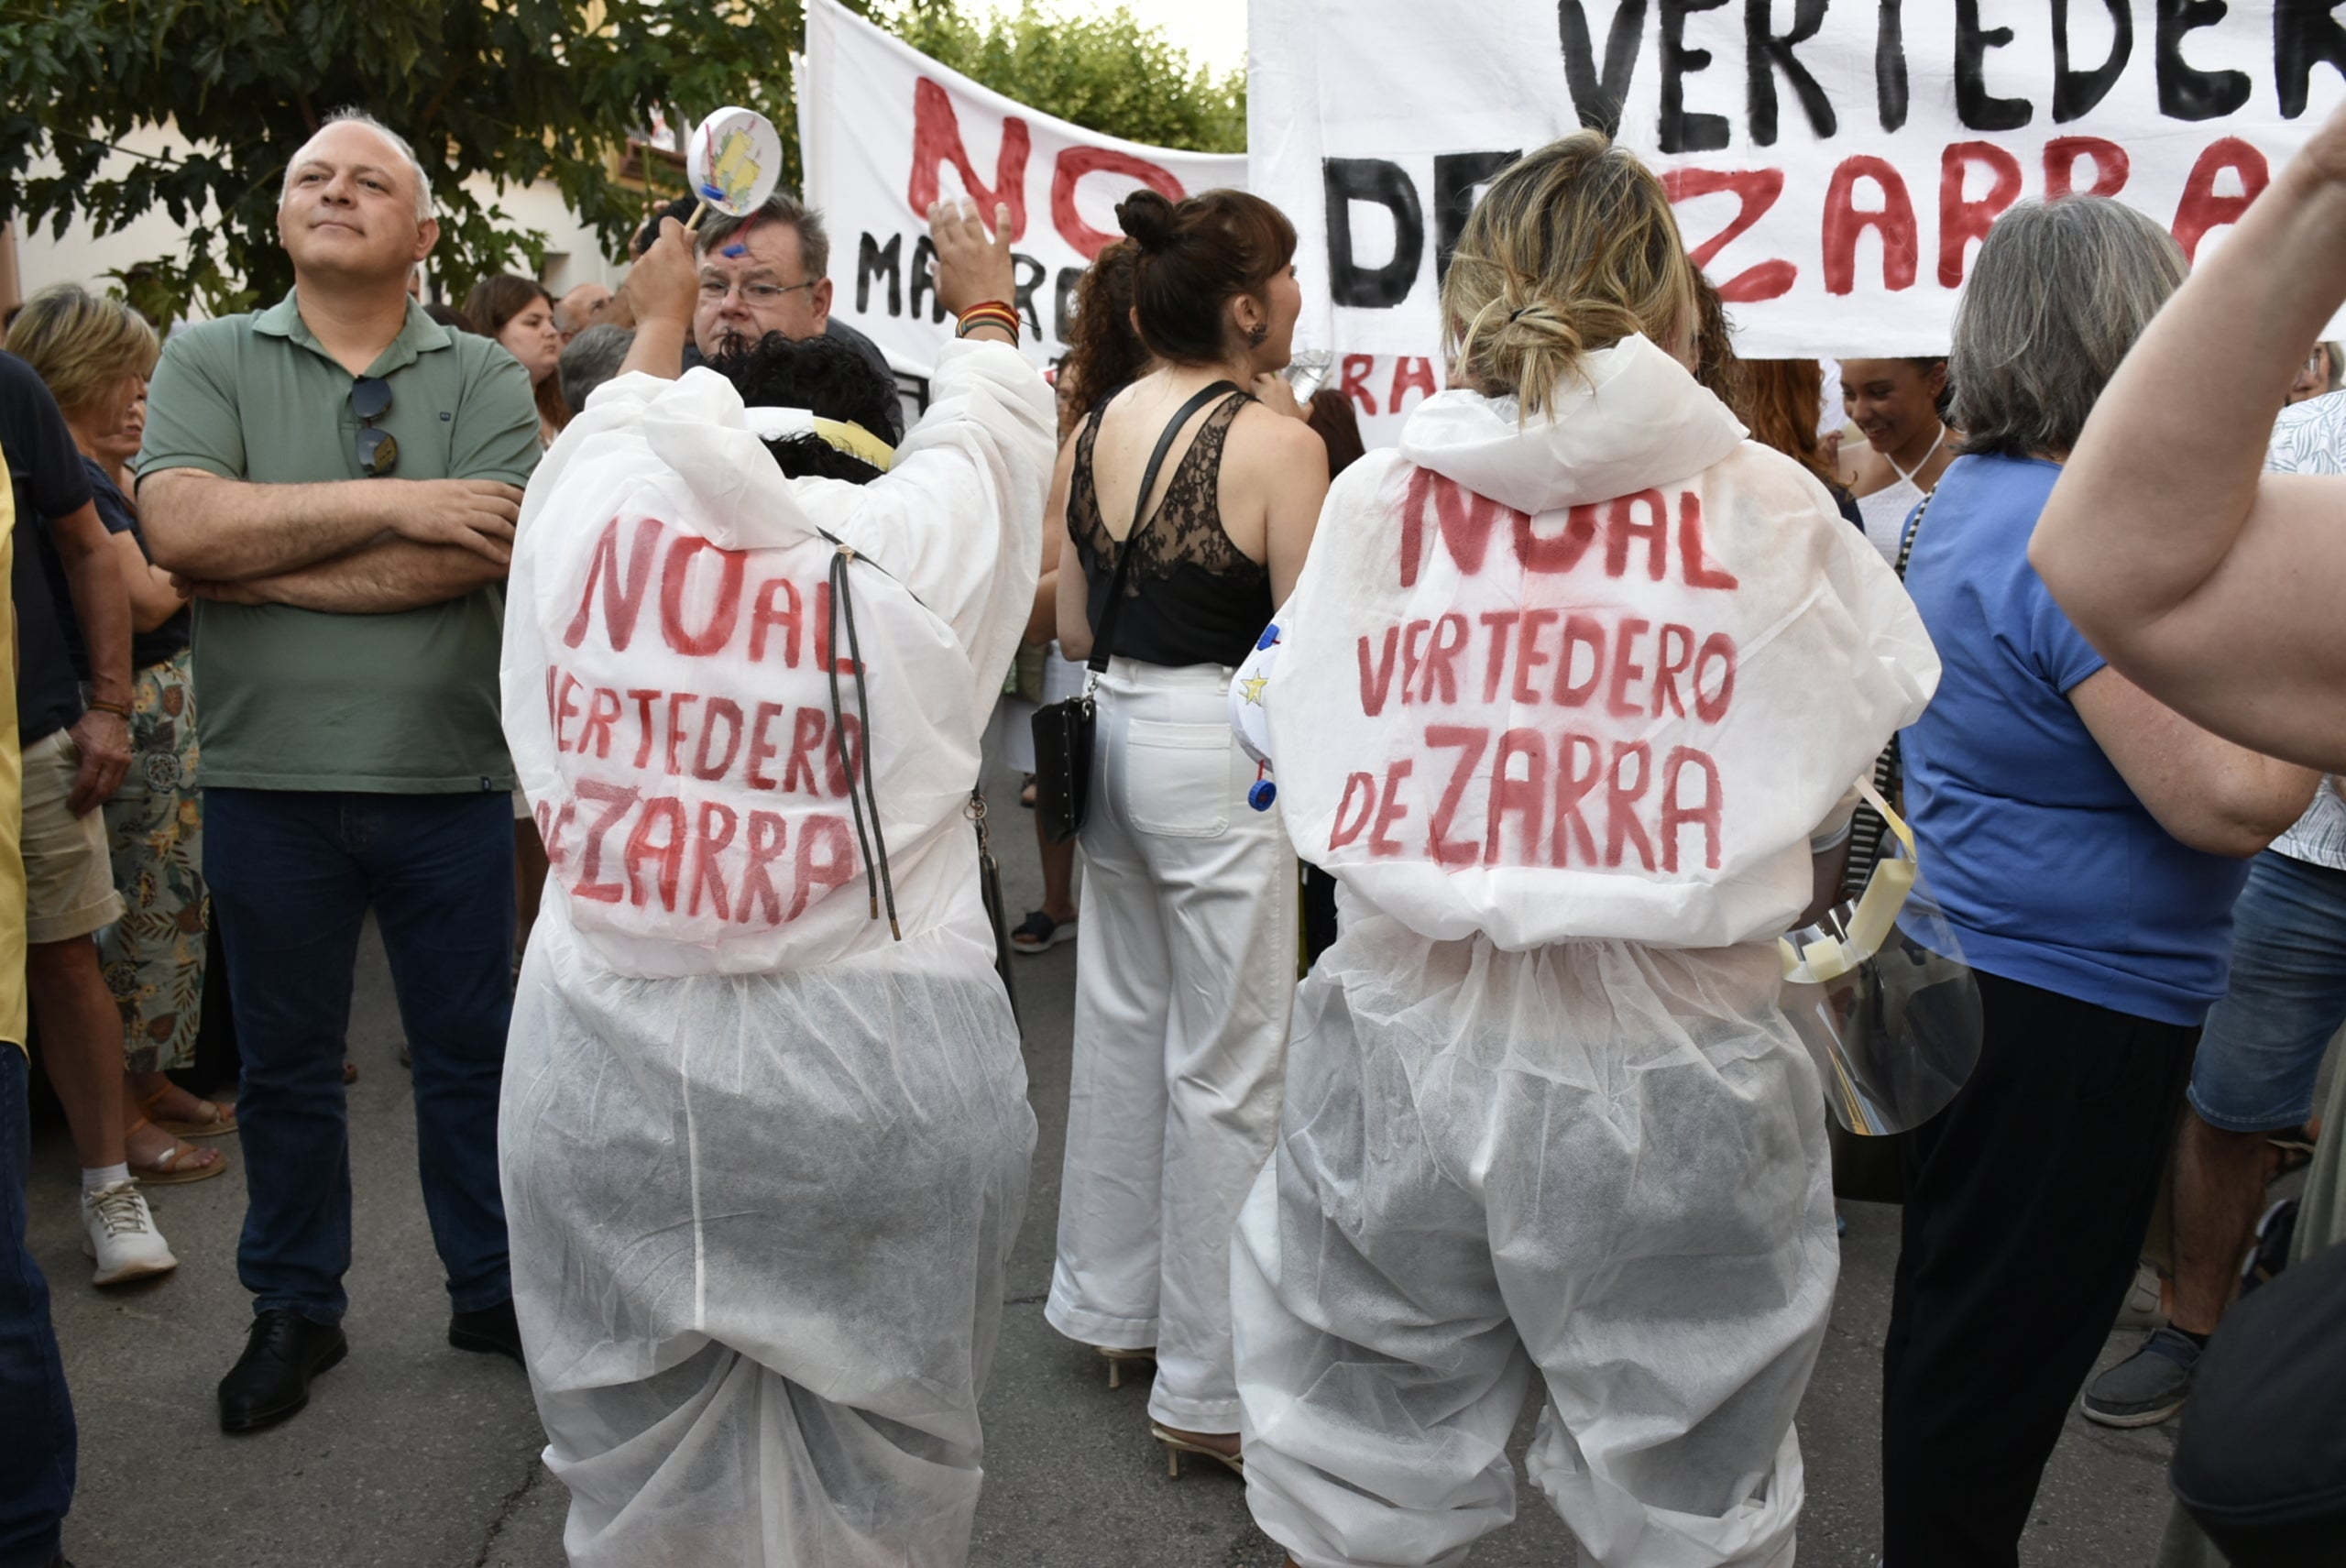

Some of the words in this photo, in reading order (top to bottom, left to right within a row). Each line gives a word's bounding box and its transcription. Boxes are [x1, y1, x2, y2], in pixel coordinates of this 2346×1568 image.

[1357, 611, 1739, 725] VERTEDERO
[1328, 759, 1414, 857] DE
[1425, 726, 1725, 875] ZARRA
